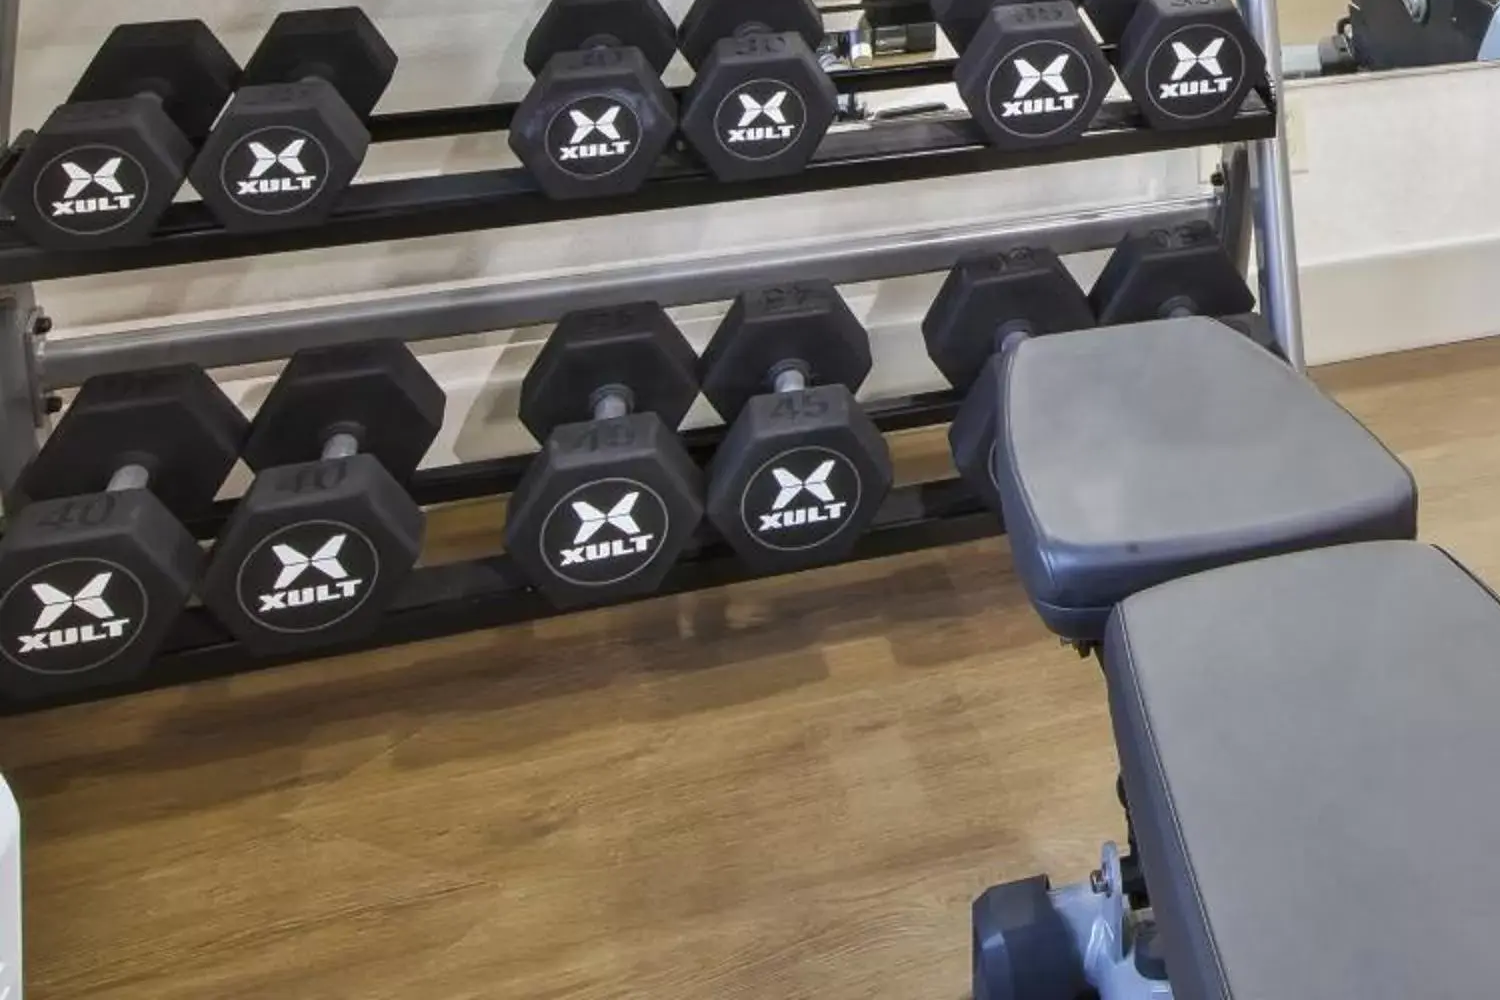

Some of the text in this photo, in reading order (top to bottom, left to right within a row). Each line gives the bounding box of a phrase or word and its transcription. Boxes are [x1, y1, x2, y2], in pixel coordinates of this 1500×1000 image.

[1159, 76, 1233, 99] XULT
[1001, 94, 1079, 117] XULT
[728, 124, 795, 143] XULT
[559, 140, 631, 161] XULT
[237, 174, 317, 195] XULT
[52, 192, 135, 217] XULT
[759, 501, 847, 531] XULT
[559, 533, 654, 566] XULT
[259, 578, 363, 612] XULT
[17, 617, 130, 654] XULT
